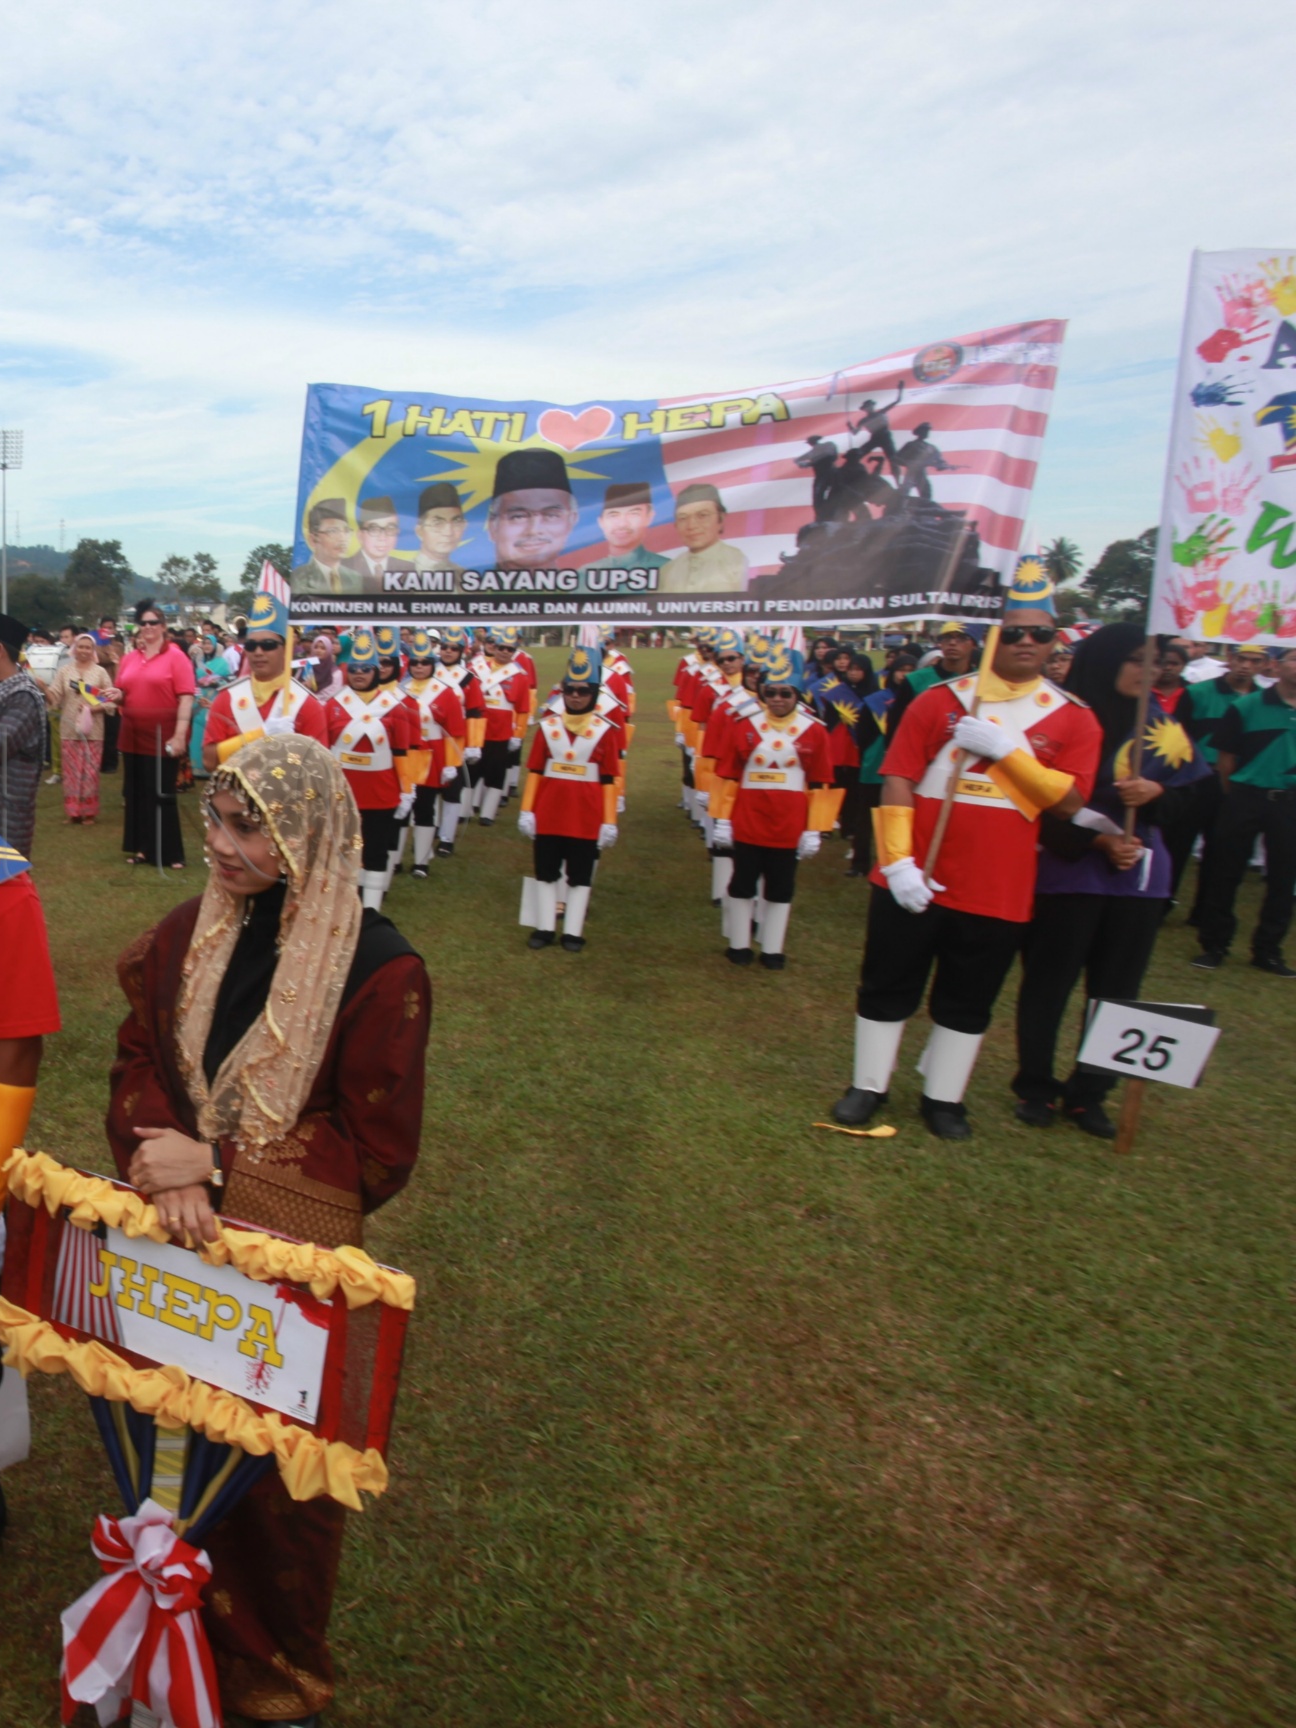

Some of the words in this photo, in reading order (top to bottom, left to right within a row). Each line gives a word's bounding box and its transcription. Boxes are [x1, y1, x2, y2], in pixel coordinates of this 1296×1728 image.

[362, 398, 393, 439] 1
[402, 404, 528, 443] HATI
[622, 392, 791, 441] HEPA
[383, 570, 453, 591] KAMI
[460, 568, 579, 591] SAYANG
[585, 567, 659, 591] UPSI
[290, 601, 373, 613] KONTINJEN
[377, 602, 407, 614] HAL
[410, 602, 465, 614] EHWAL
[468, 601, 541, 614] PELAJAR
[544, 602, 578, 614] DAN
[580, 602, 653, 616] ALUMNI,
[656, 599, 760, 614] UNIVERSITI
[764, 596, 884, 613] PENDIDIKAN
[1111, 1027, 1179, 1072] 25
[89, 1249, 284, 1369] JHEPA
